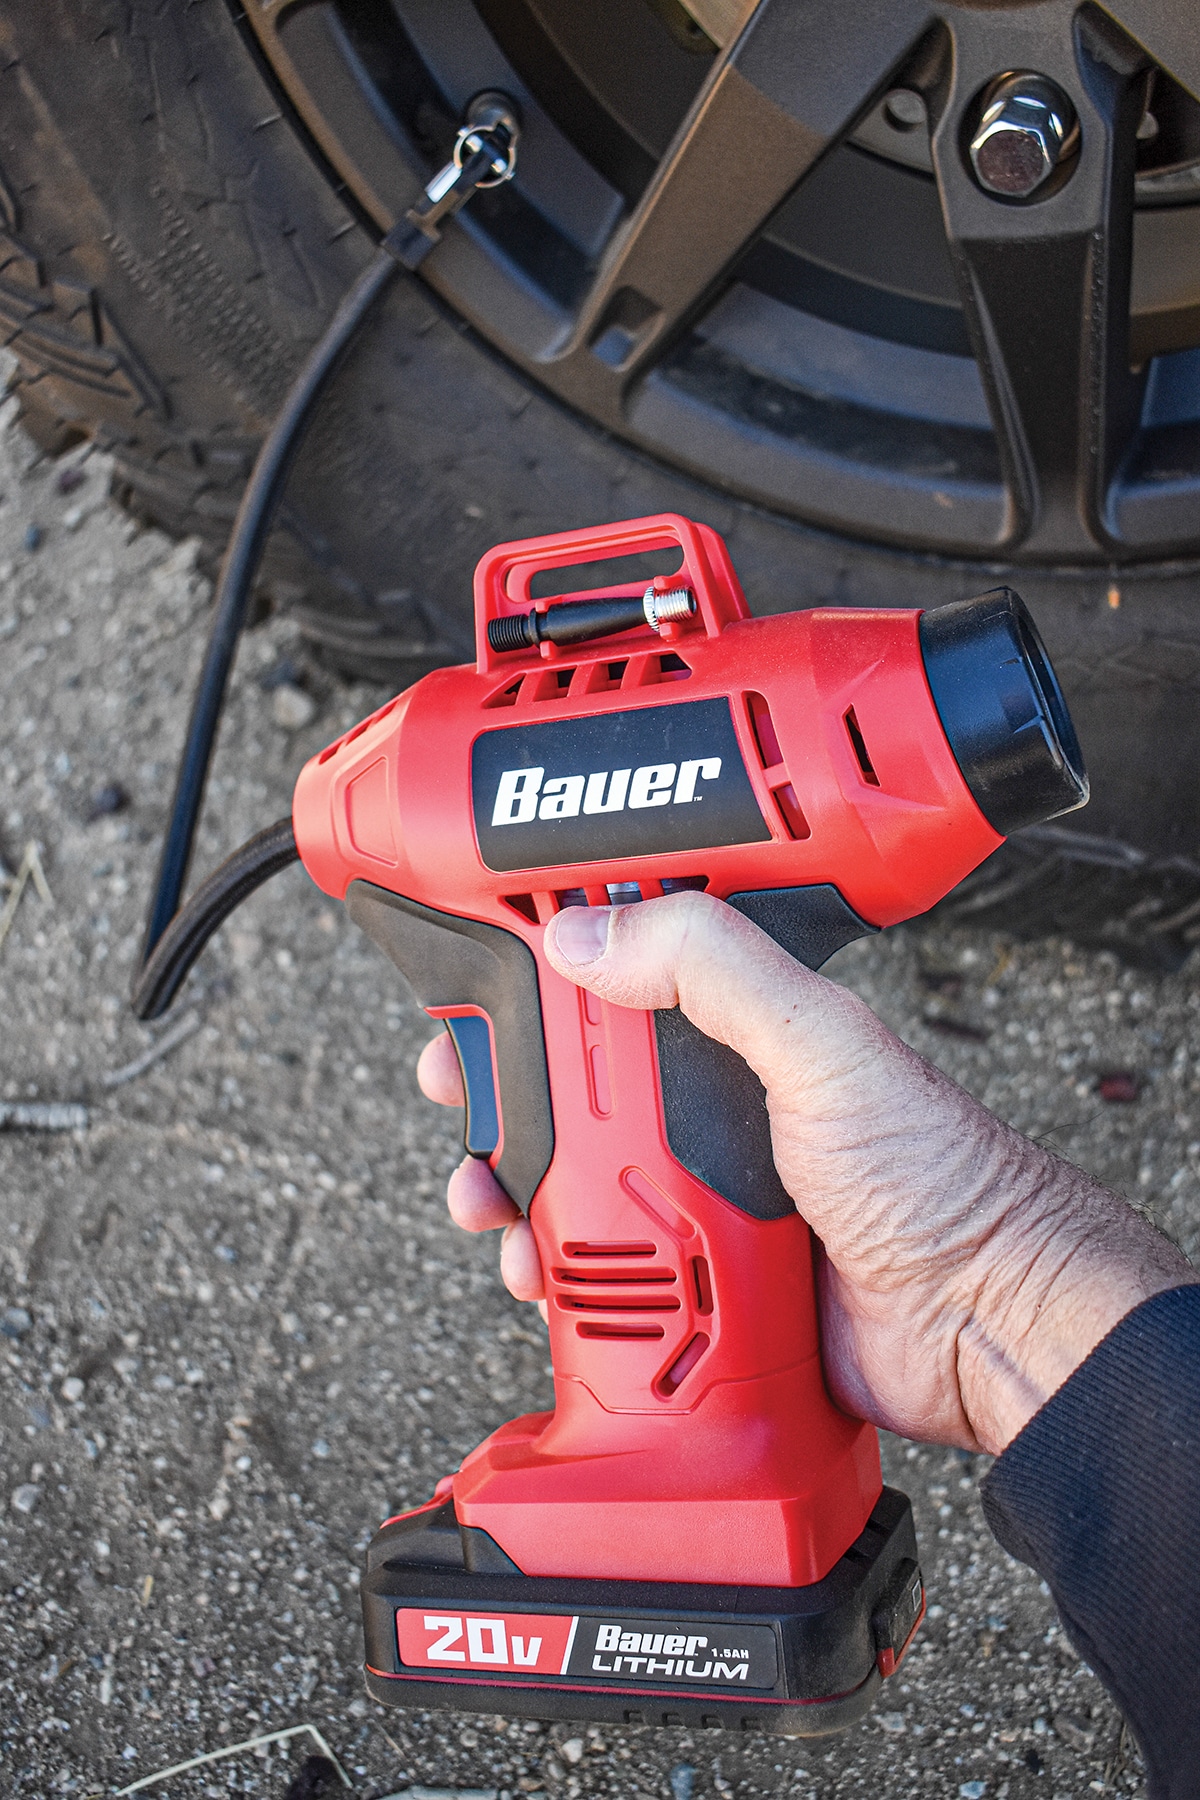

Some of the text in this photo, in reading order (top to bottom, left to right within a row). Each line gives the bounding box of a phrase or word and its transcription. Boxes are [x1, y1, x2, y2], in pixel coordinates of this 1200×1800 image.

[491, 757, 722, 827] Bauer
[594, 1624, 750, 1660] Bauer 1.5AH
[591, 1654, 750, 1681] LITHIUM
